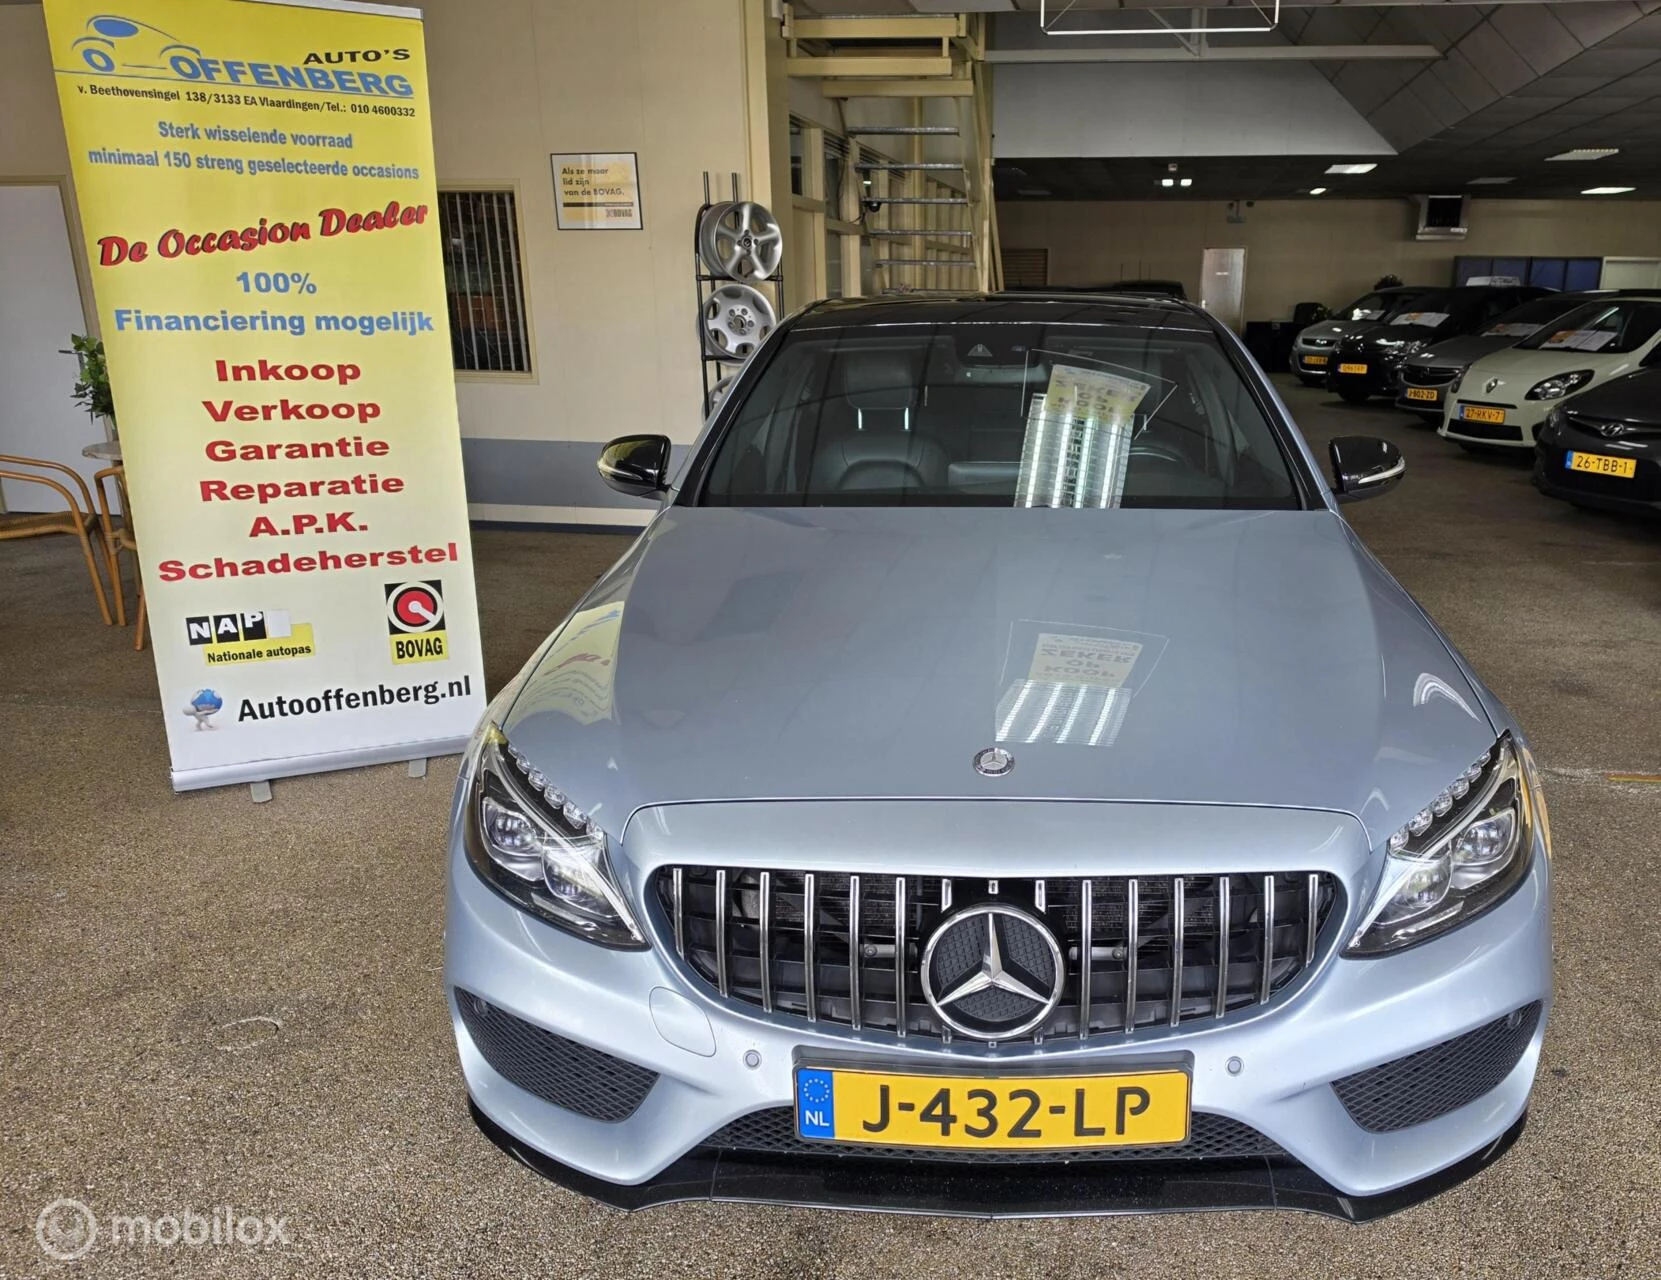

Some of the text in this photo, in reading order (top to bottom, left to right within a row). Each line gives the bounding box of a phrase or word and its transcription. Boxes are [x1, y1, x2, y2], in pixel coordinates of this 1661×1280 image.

[169, 55, 413, 97] OFFENBERG
[77, 86, 88, 94] v.
[90, 84, 180, 101] Beethovensingel
[186, 91, 242, 105] 138/3133
[244, 96, 258, 106] EA
[350, 104, 370, 114] 010
[371, 106, 415, 117] 4600332
[158, 121, 353, 149] Sterk wisselende voorraad
[88, 149, 420, 180] minimaal 150 streng geselecteerde occasions
[562, 167, 574, 175] Als
[581, 188, 592, 196] de
[97, 200, 429, 267] De Occasion Dealer
[236, 272, 317, 295] 100%
[114, 309, 434, 337] Financiering mogelijk
[215, 359, 361, 385] Inkoop
[202, 399, 381, 424] Verkoop
[205, 436, 390, 462] Garantie
[1576, 455, 1628, 474] 26-TBB-1
[199, 474, 405, 503] Reparatie
[249, 512, 368, 538] A.P.K.
[158, 542, 459, 582] Schadeherstel
[189, 612, 264, 639] NAP
[207, 644, 312, 664] Nationale autopas
[395, 640, 443, 659] BOVAG
[237, 675, 472, 723] Autooffenberg.nl
[805, 1110, 830, 1127] NL
[862, 1084, 1150, 1138] J-432-LP
